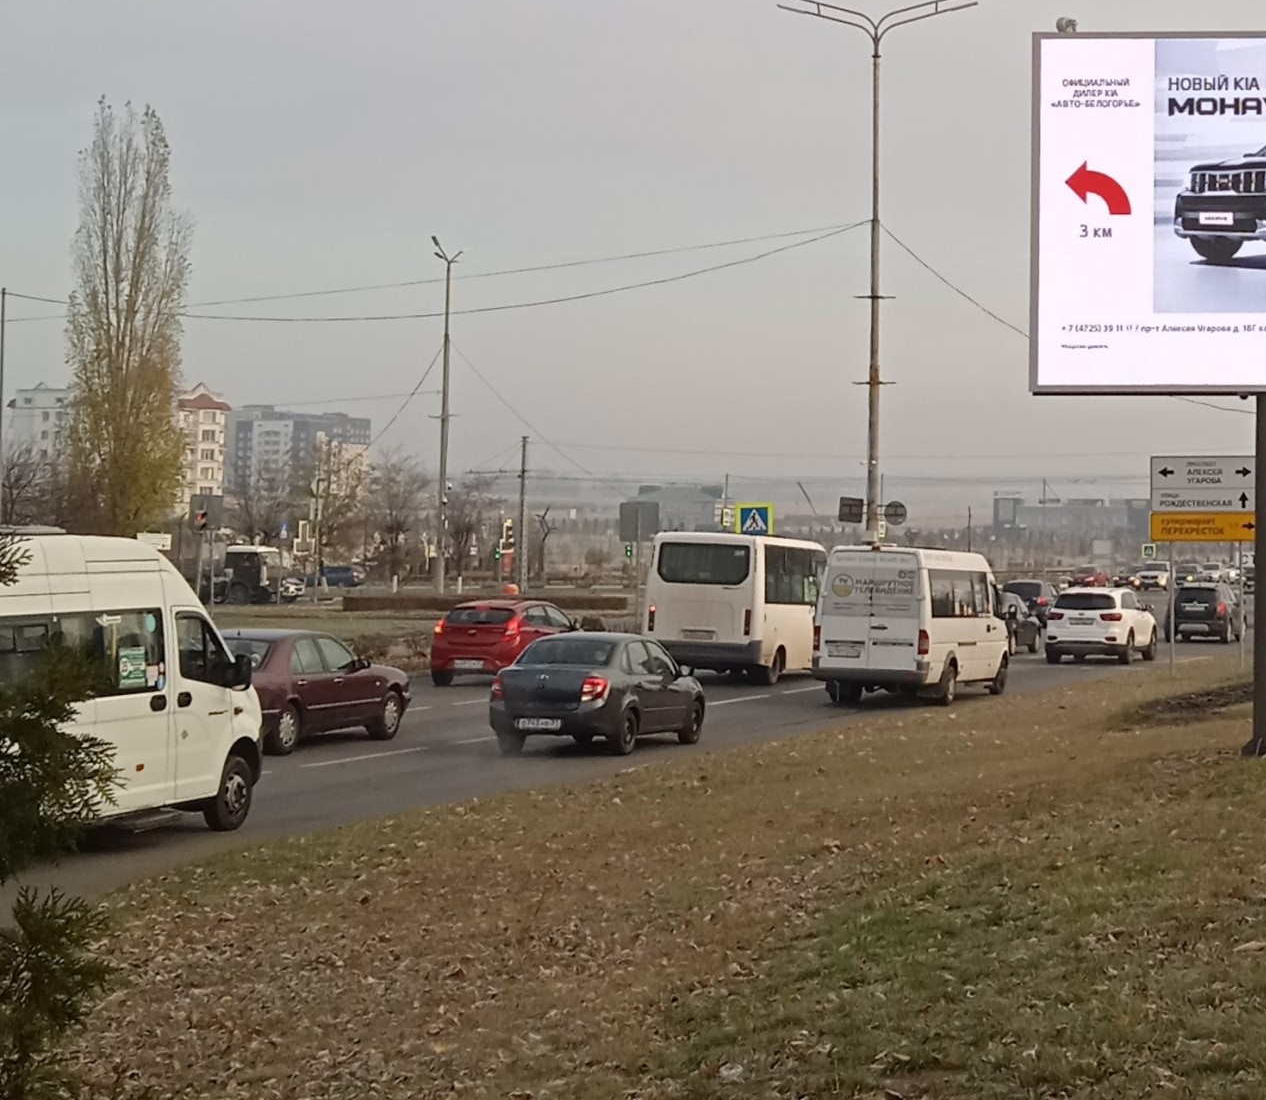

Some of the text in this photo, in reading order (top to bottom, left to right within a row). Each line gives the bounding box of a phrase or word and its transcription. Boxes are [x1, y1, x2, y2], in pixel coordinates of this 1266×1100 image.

[1061, 77, 1130, 88] ОФИЦИАЛЬНЫЙ
[1168, 74, 1260, 91] НОВЫЙ KIA
[1072, 89, 1119, 99] ДИЛЕР KIA
[1050, 99, 1141, 109] «АВТО-БЕЛОГОРЬЕ»
[1079, 223, 1112, 238] 3 км
